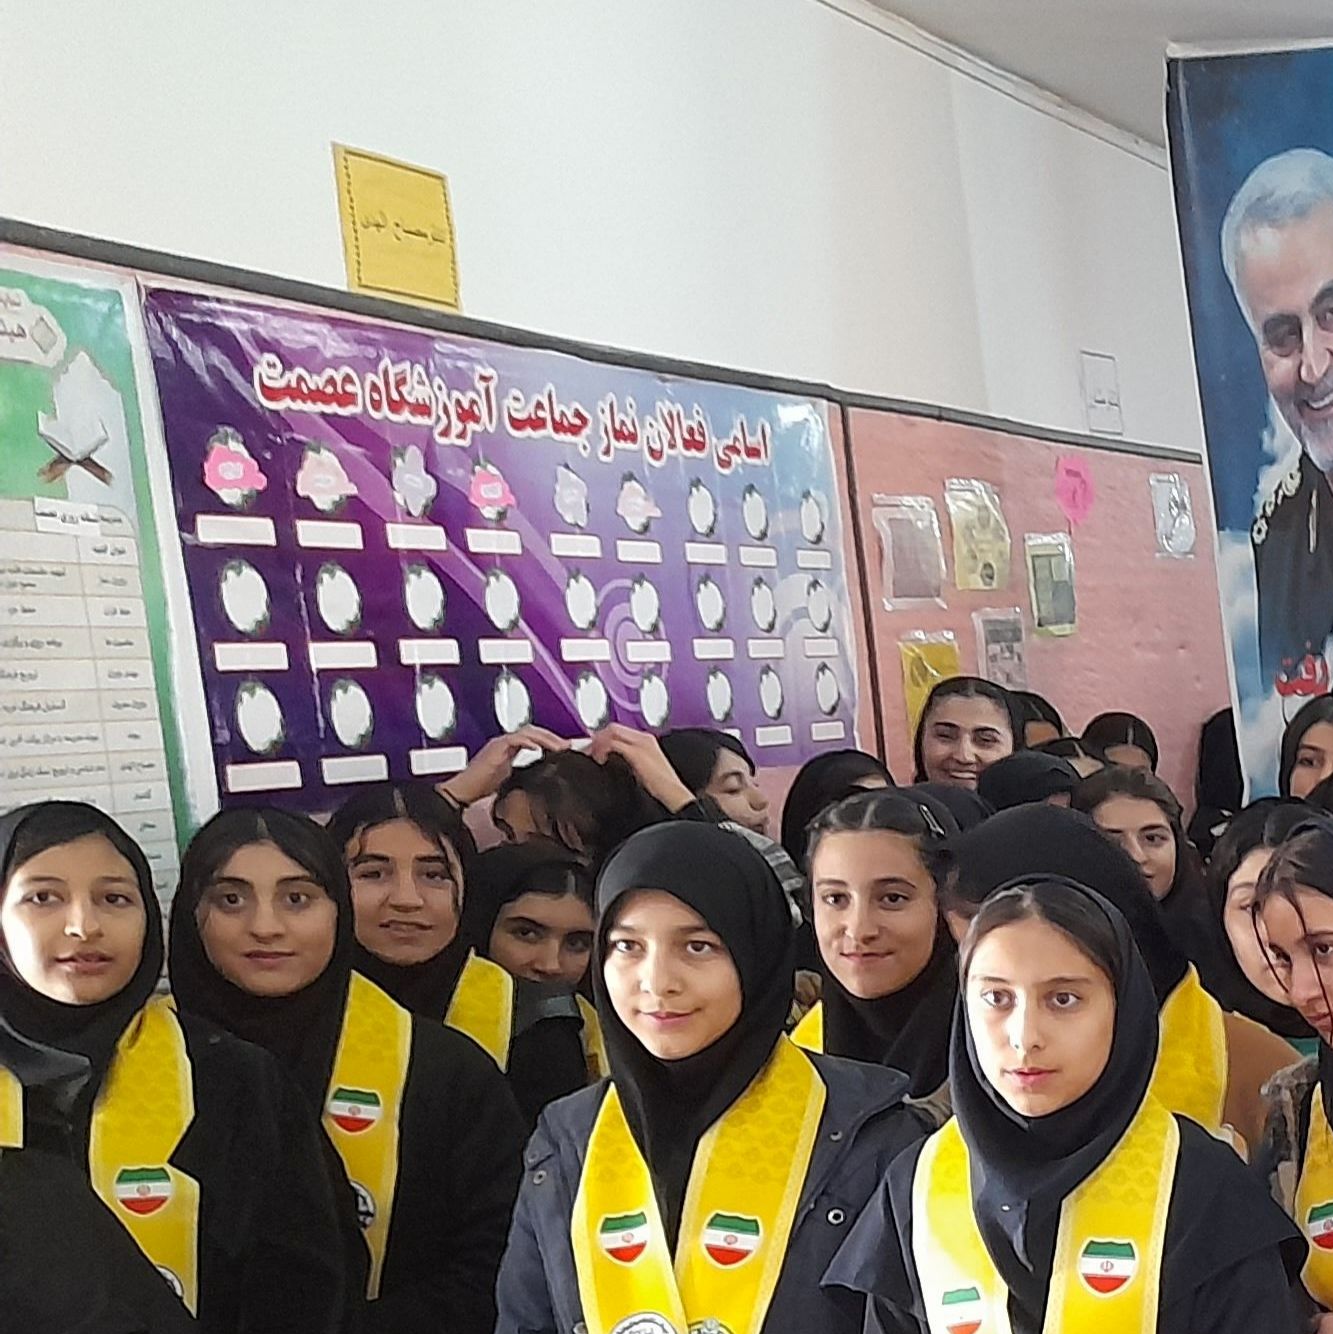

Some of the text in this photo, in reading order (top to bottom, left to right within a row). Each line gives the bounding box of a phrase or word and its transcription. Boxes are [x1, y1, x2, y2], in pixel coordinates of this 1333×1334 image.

[255, 354, 769, 469] اسامی فعالان نماز جماعت آموزشگاه عصمت
